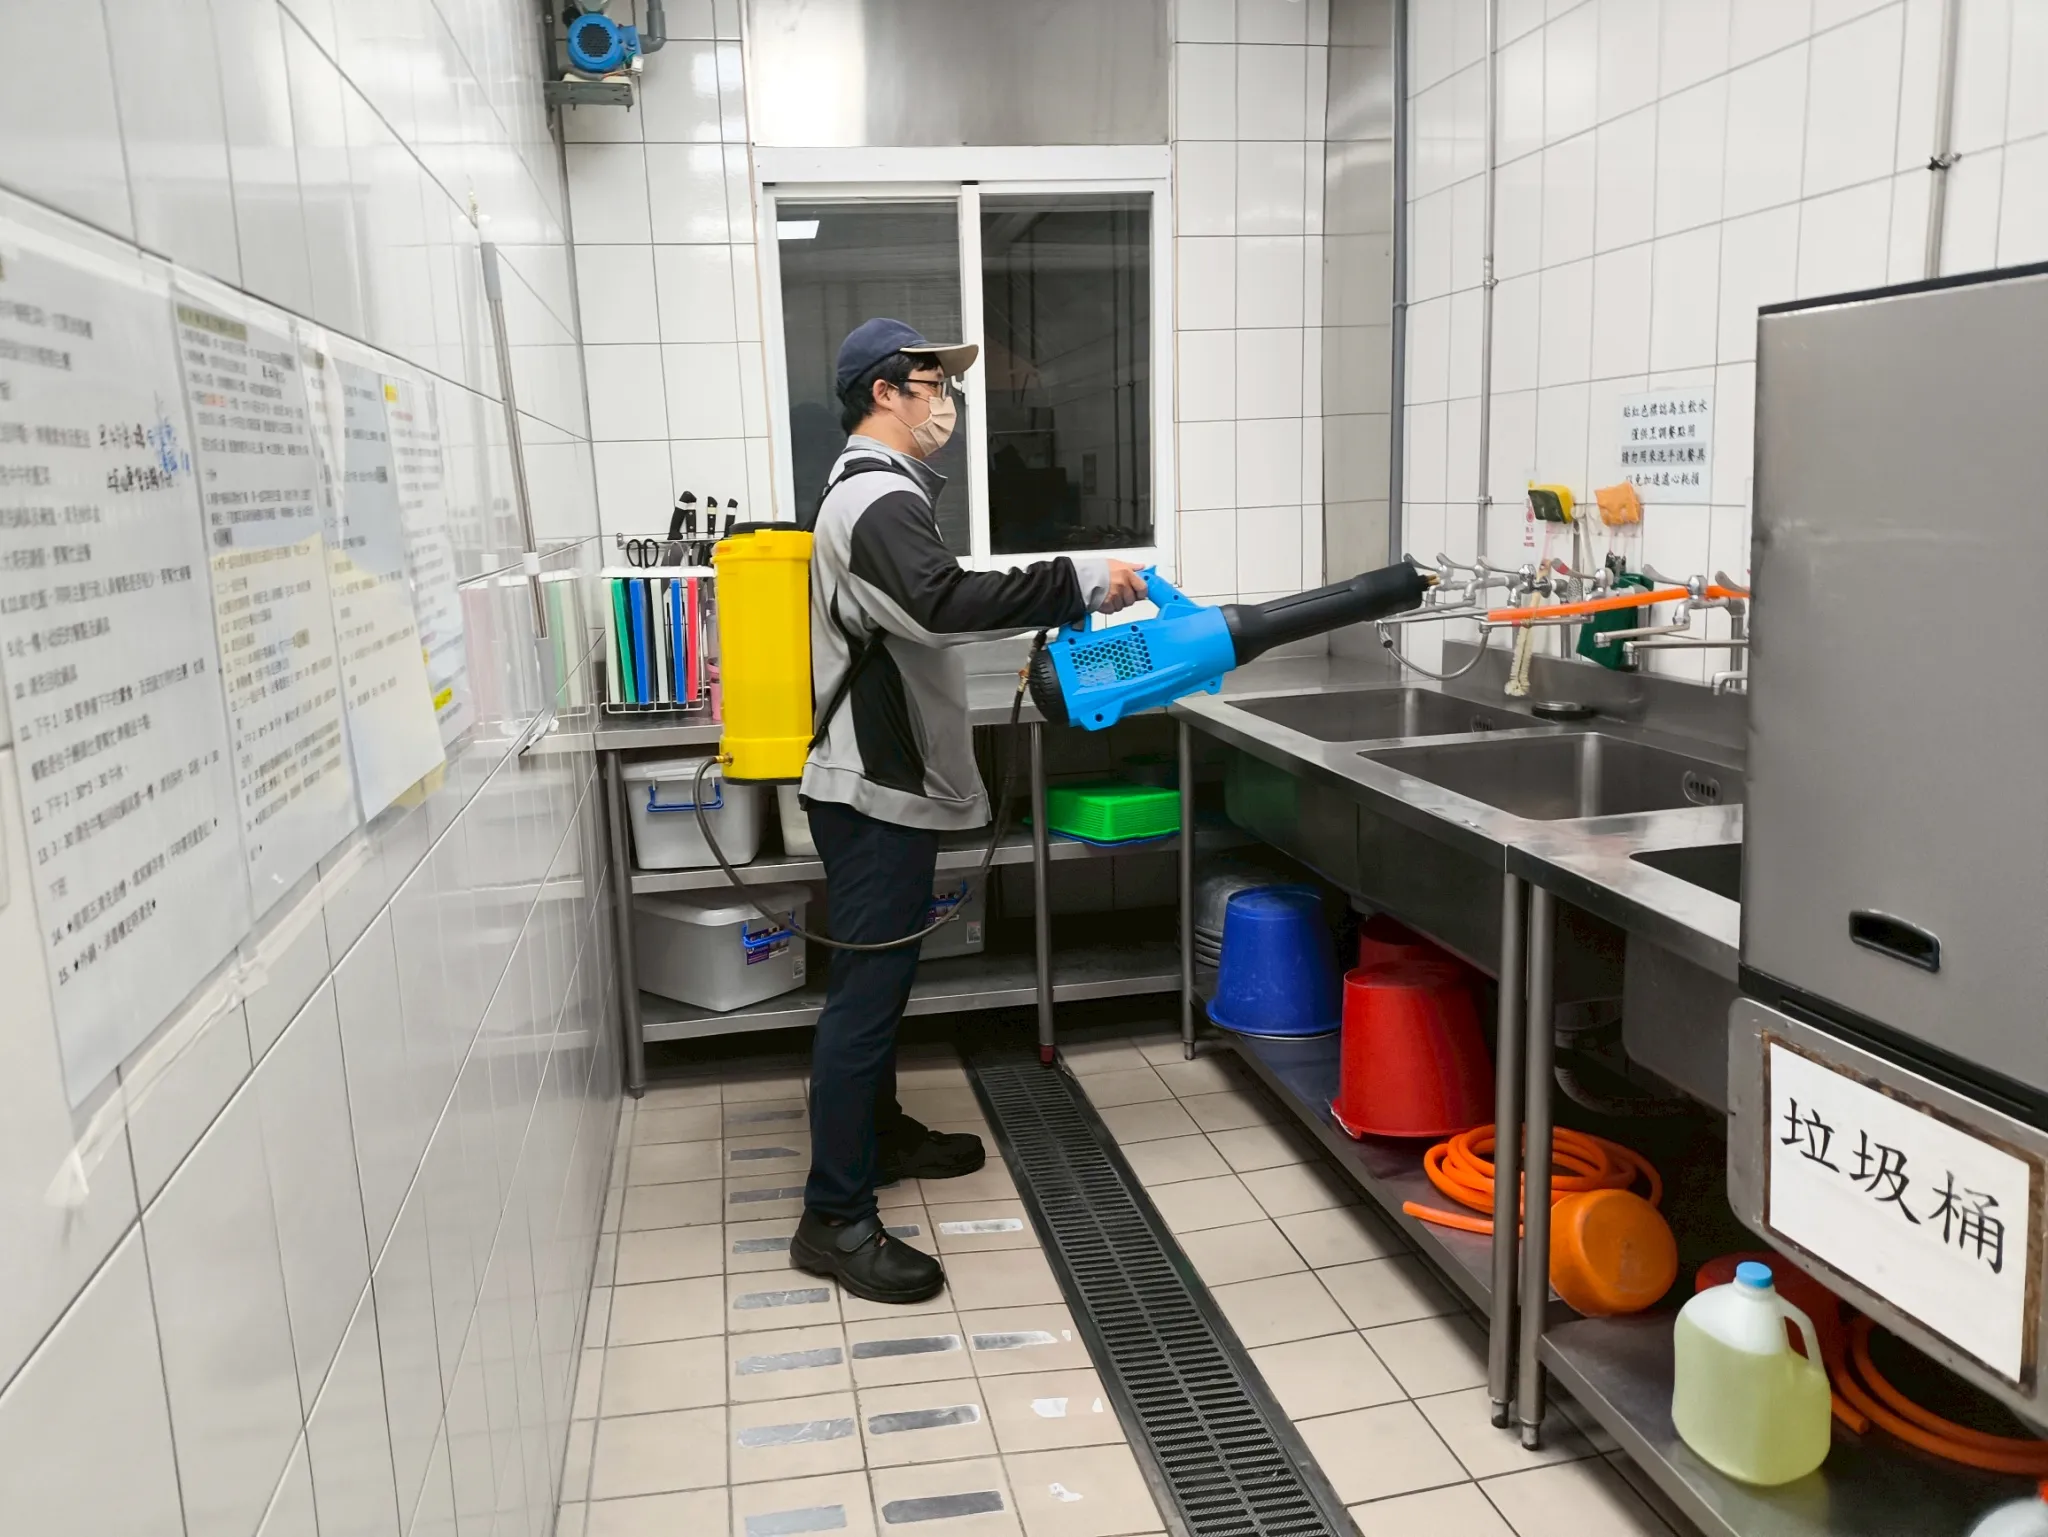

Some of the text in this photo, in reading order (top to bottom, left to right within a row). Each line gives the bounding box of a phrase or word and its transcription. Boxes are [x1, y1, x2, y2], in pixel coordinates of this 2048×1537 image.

[1631, 425, 1695, 440] 僅供烹調餐點用
[1622, 448, 1705, 464] 請勿用來洗手洗餐具
[1780, 1098, 2007, 1275] 垃圾桶
